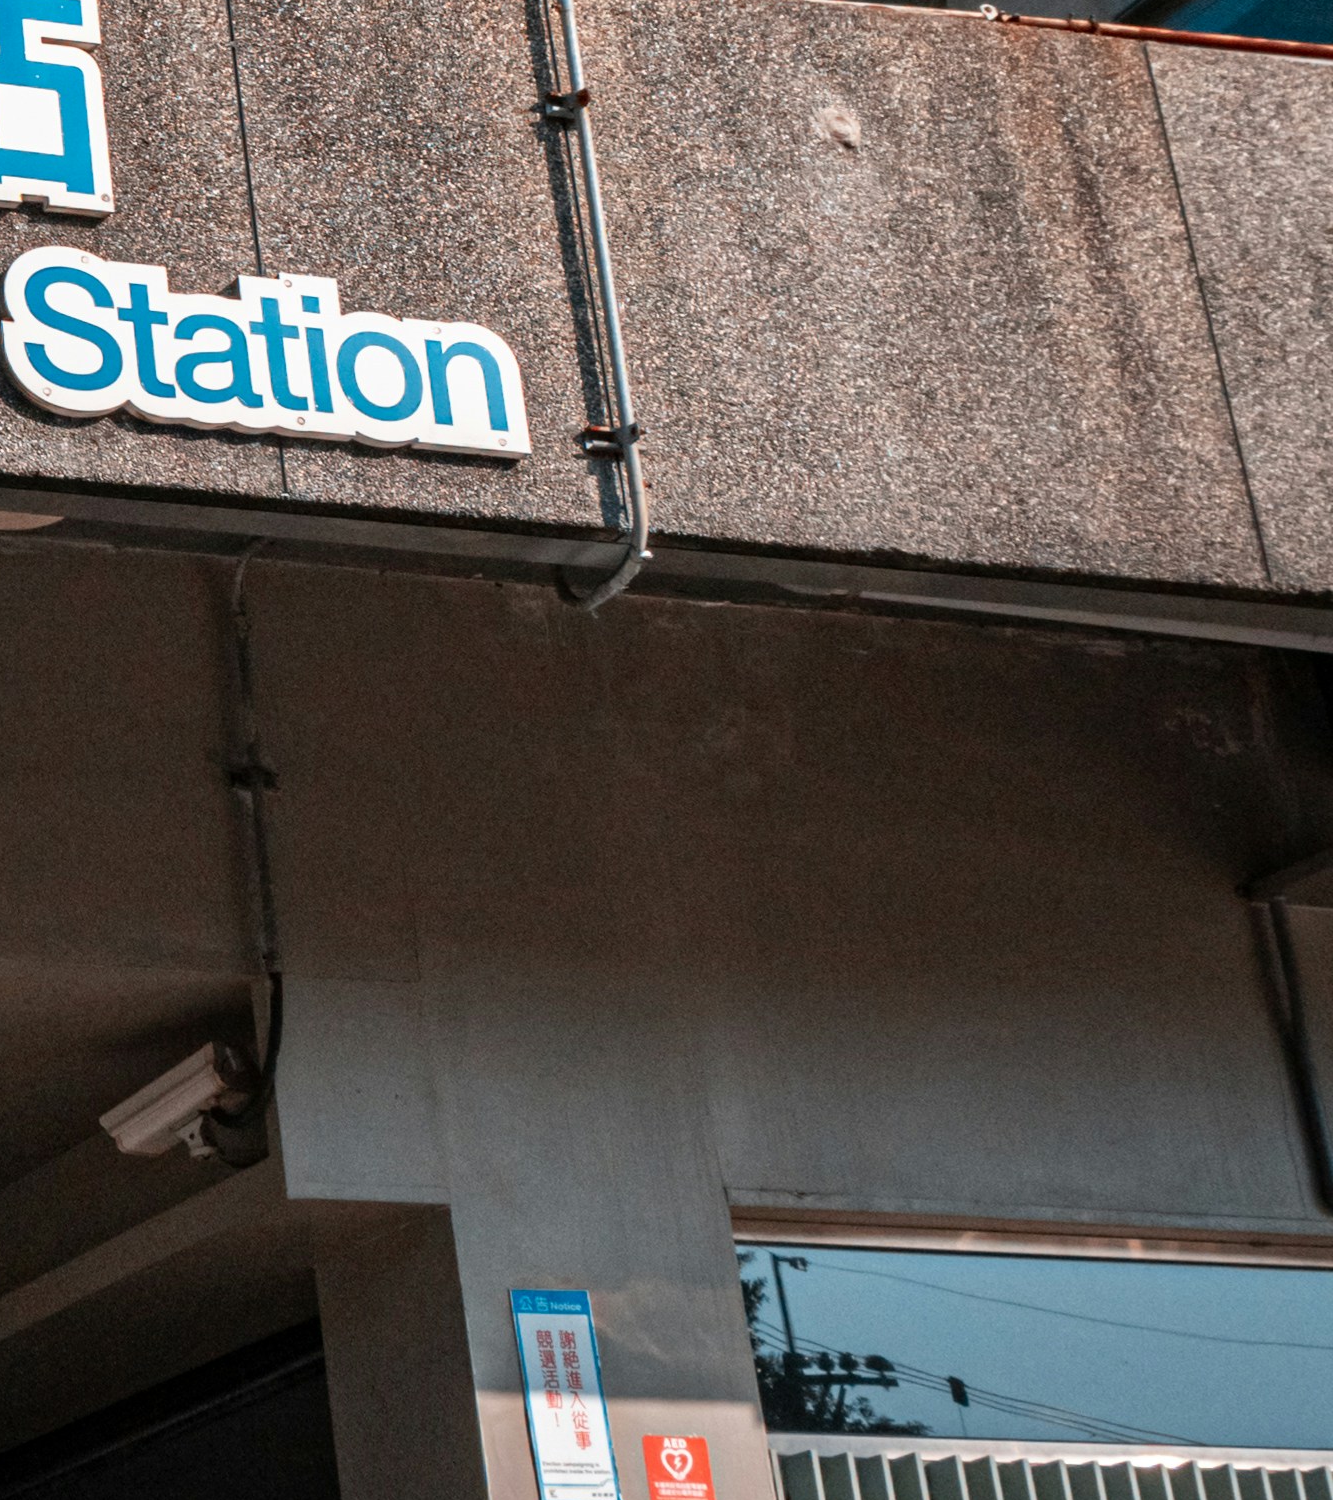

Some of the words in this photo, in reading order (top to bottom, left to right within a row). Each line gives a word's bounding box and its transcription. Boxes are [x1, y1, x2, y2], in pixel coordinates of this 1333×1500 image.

[23, 265, 510, 432] Station
[550, 1301, 582, 1312] Notice
[663, 1438, 687, 1449] AED
